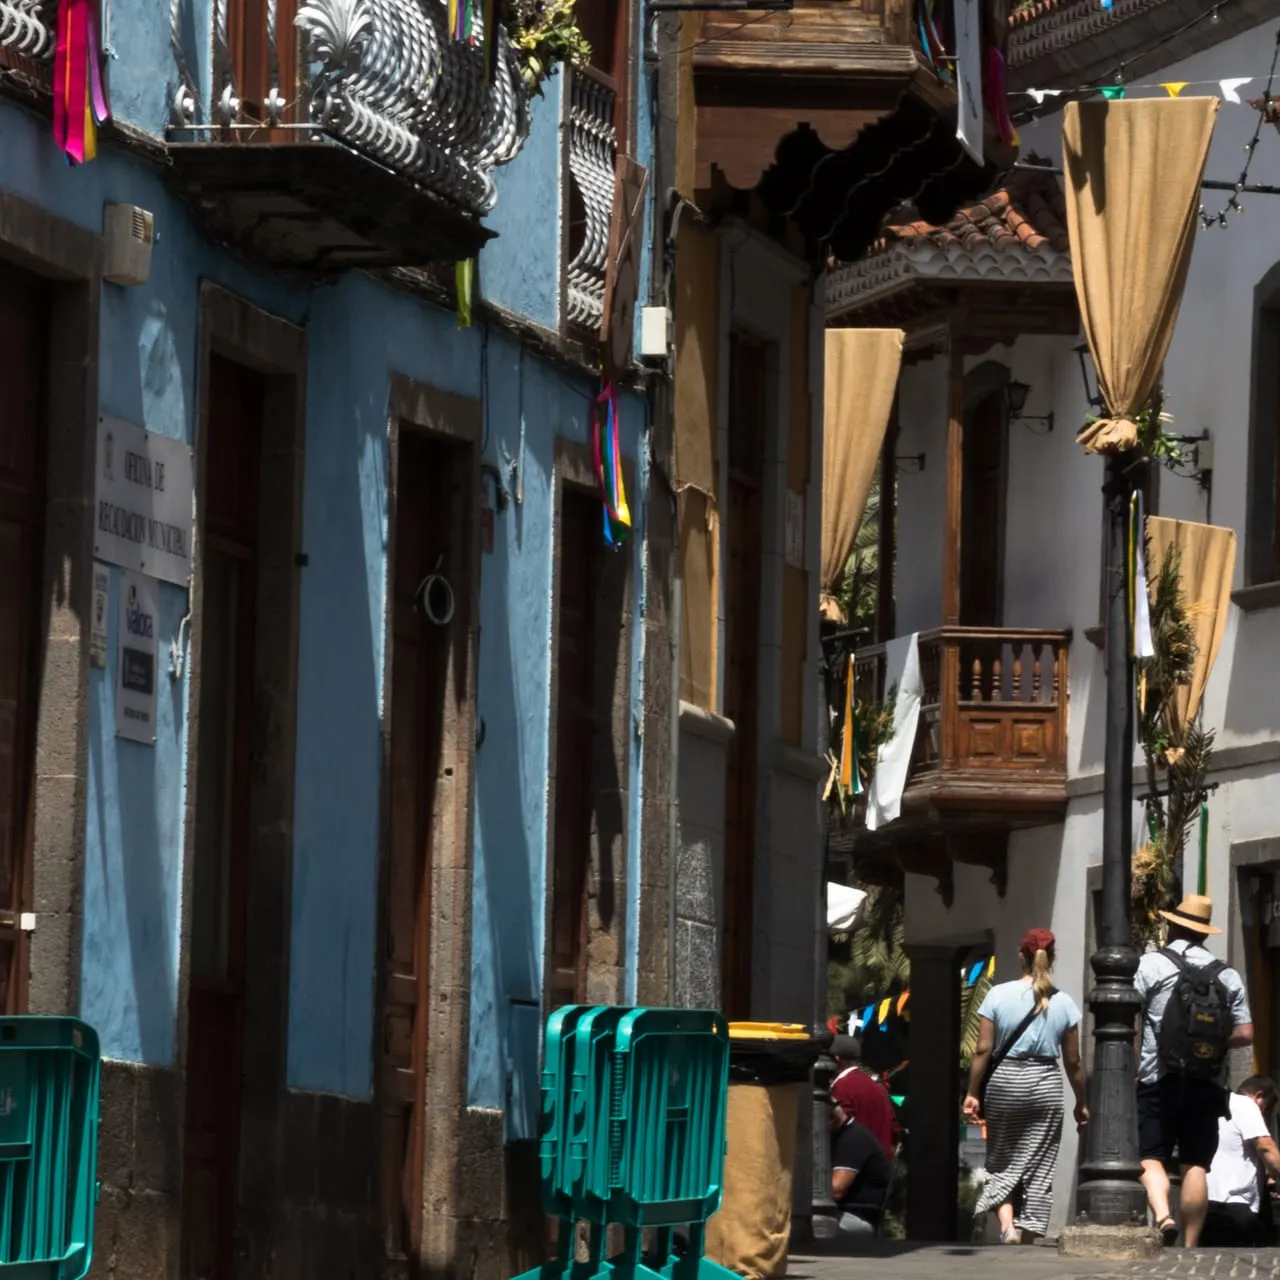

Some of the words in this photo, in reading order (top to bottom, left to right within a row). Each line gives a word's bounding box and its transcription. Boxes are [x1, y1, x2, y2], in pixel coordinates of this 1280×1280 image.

[125, 450, 153, 488] OFICINA
[155, 461, 165, 492] DE
[126, 603, 154, 638] valora
